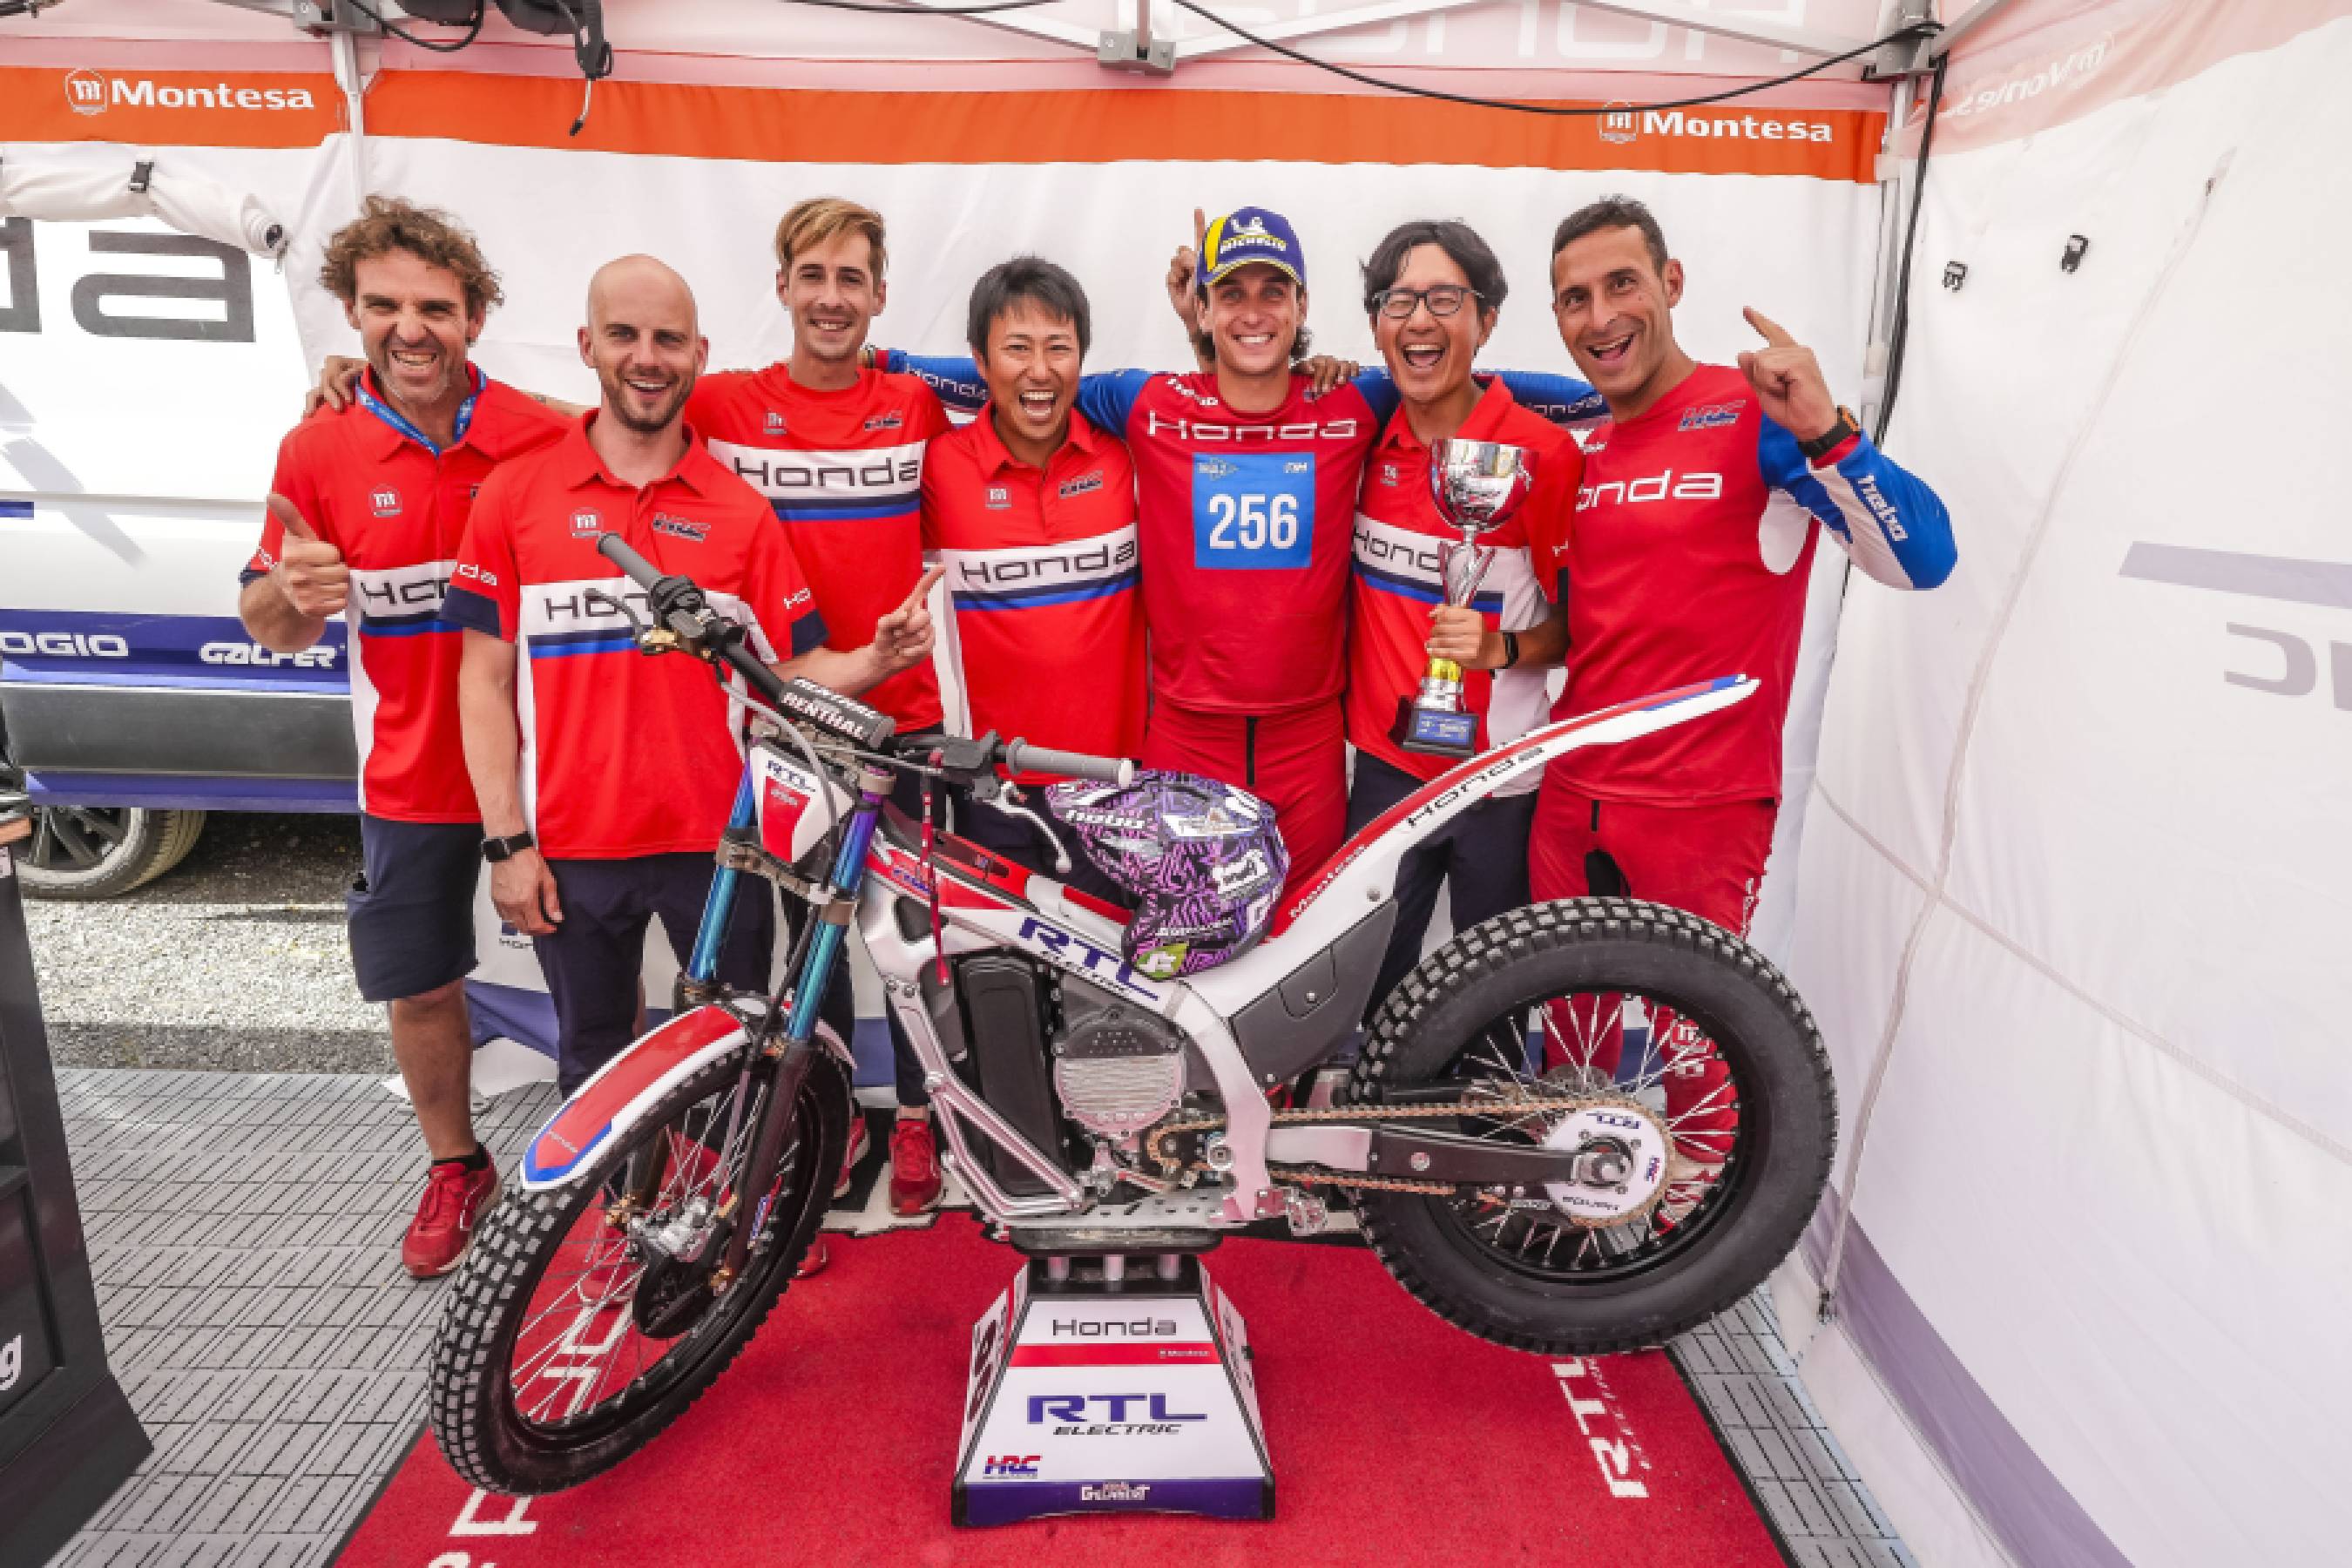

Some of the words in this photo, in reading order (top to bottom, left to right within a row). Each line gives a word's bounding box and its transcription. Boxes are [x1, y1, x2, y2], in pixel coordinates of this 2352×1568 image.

[112, 79, 314, 110] Montesa
[1644, 110, 1832, 142] Montesa
[1147, 411, 1356, 440] Honda
[733, 457, 920, 488] Honda
[1209, 494, 1298, 550] 256
[958, 538, 1135, 584] Honda
[0, 632, 129, 657] OGIO
[781, 693, 865, 740] RENTHAL
[1408, 747, 1545, 828] Honda
[1288, 844, 1366, 919] Montesa
[1018, 916, 1159, 1001] RTL
[1052, 1317, 1177, 1337] Honda
[1026, 1393, 1208, 1425] RTL
[1052, 1423, 1182, 1436] ELECTRIC
[984, 1455, 1043, 1476] HRC
